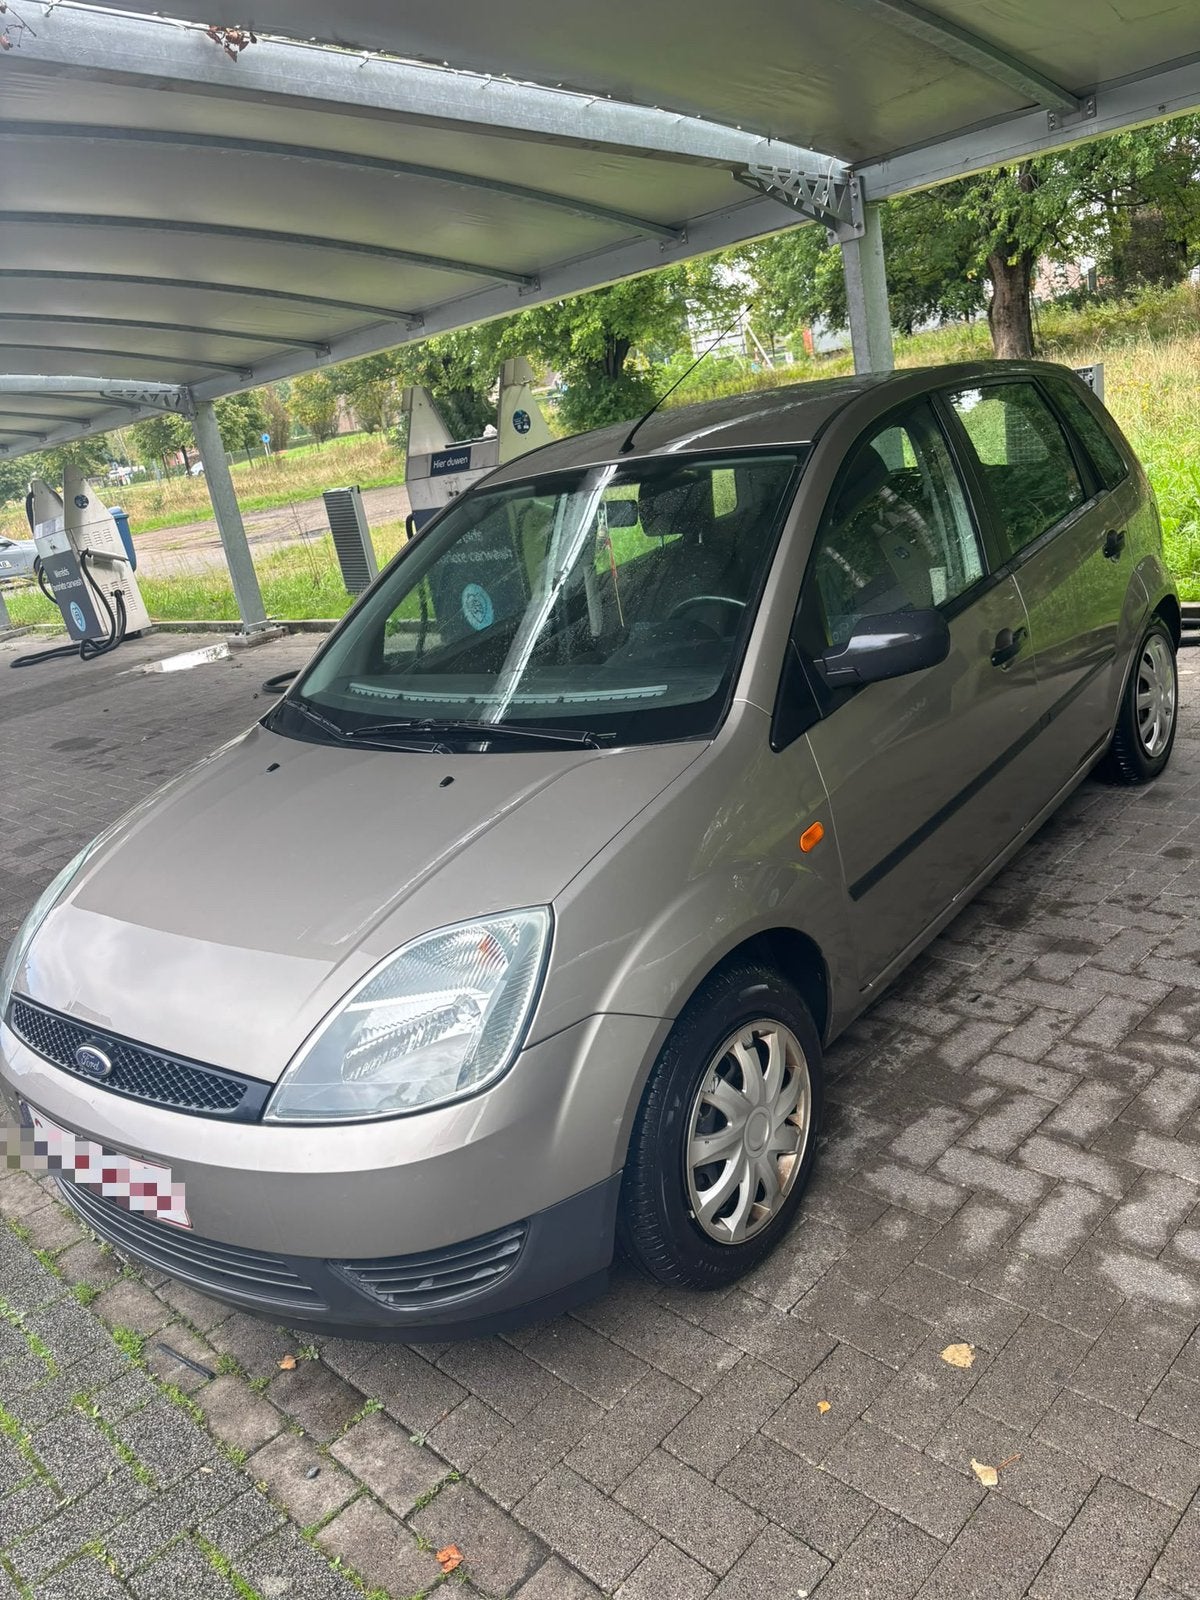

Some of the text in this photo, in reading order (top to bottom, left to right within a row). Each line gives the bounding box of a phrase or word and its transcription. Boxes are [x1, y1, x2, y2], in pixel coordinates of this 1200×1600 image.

[433, 457, 468, 469] Hier duwen
[81, 1052, 99, 1071] Ford
